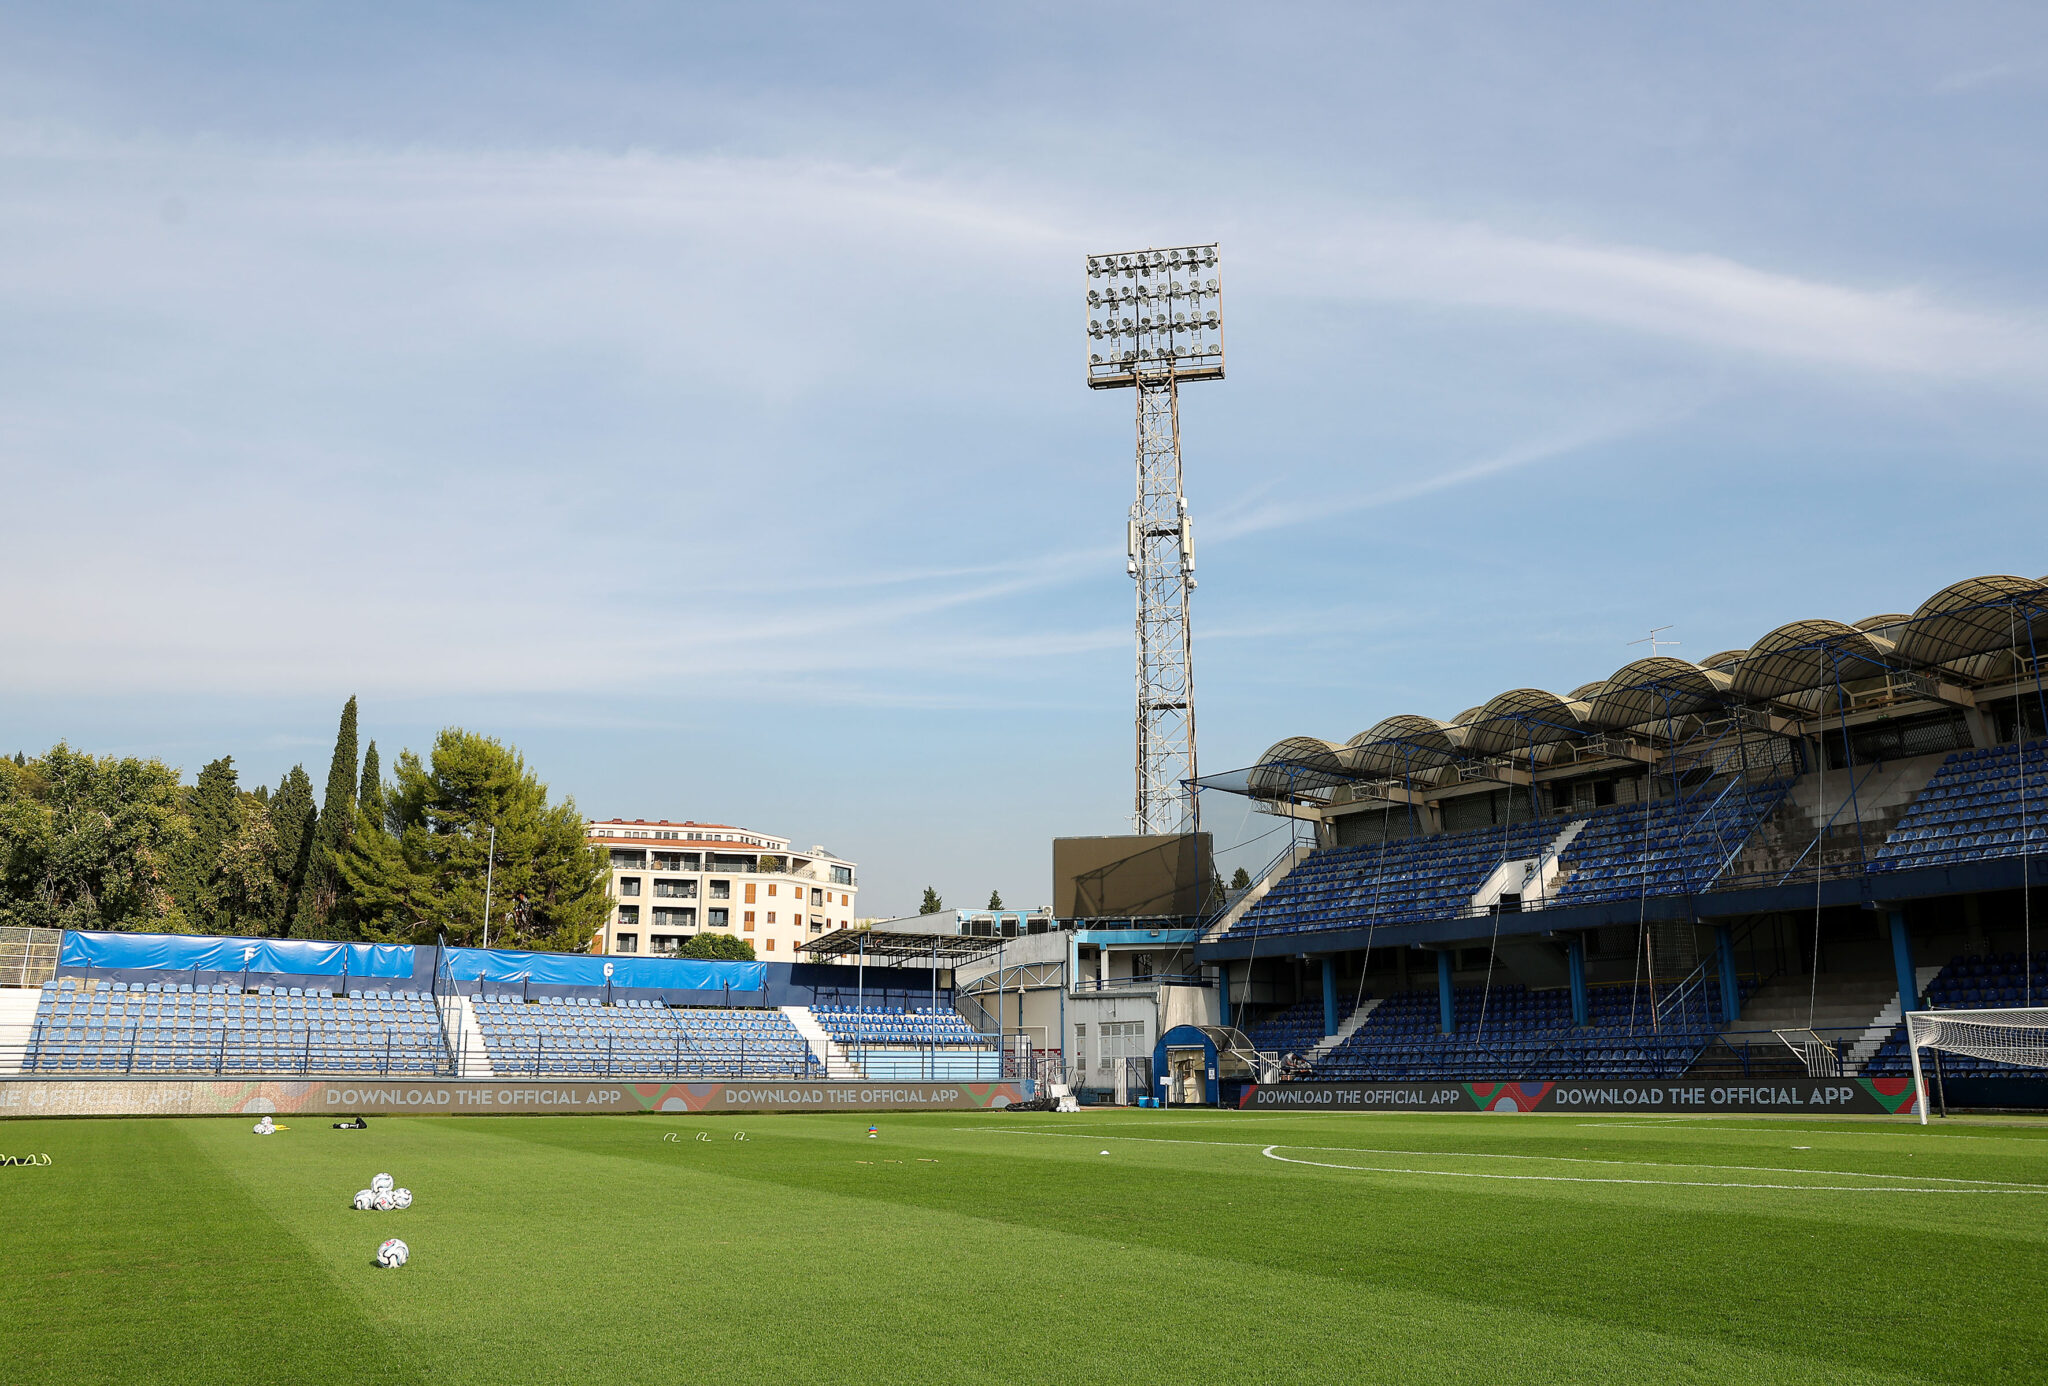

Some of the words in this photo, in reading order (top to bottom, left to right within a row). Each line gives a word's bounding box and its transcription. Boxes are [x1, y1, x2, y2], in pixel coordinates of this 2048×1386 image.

[244, 947, 256, 961] F
[603, 962, 614, 976] G
[28, 1089, 140, 1107] OFFICIAL
[147, 1089, 192, 1106] APP
[326, 1089, 451, 1105] DOWNLOAD
[456, 1090, 493, 1105] THE
[498, 1089, 582, 1105] OFFICIAL
[586, 1089, 621, 1105] APP
[726, 1090, 823, 1104] DOWNLOAD
[827, 1090, 858, 1104] THE
[860, 1089, 928, 1104] OFFICIAL
[931, 1089, 959, 1103] APP
[1257, 1090, 1331, 1105] DOWNLOAD
[1336, 1090, 1361, 1104] THE
[1364, 1090, 1427, 1105] OFFICIAL
[1430, 1090, 1460, 1104] APP
[1556, 1088, 1664, 1105] DOWNLOAD
[1668, 1088, 1705, 1104] THE
[1709, 1087, 1804, 1105] OFFICIAL
[1809, 1087, 1854, 1105] APP
